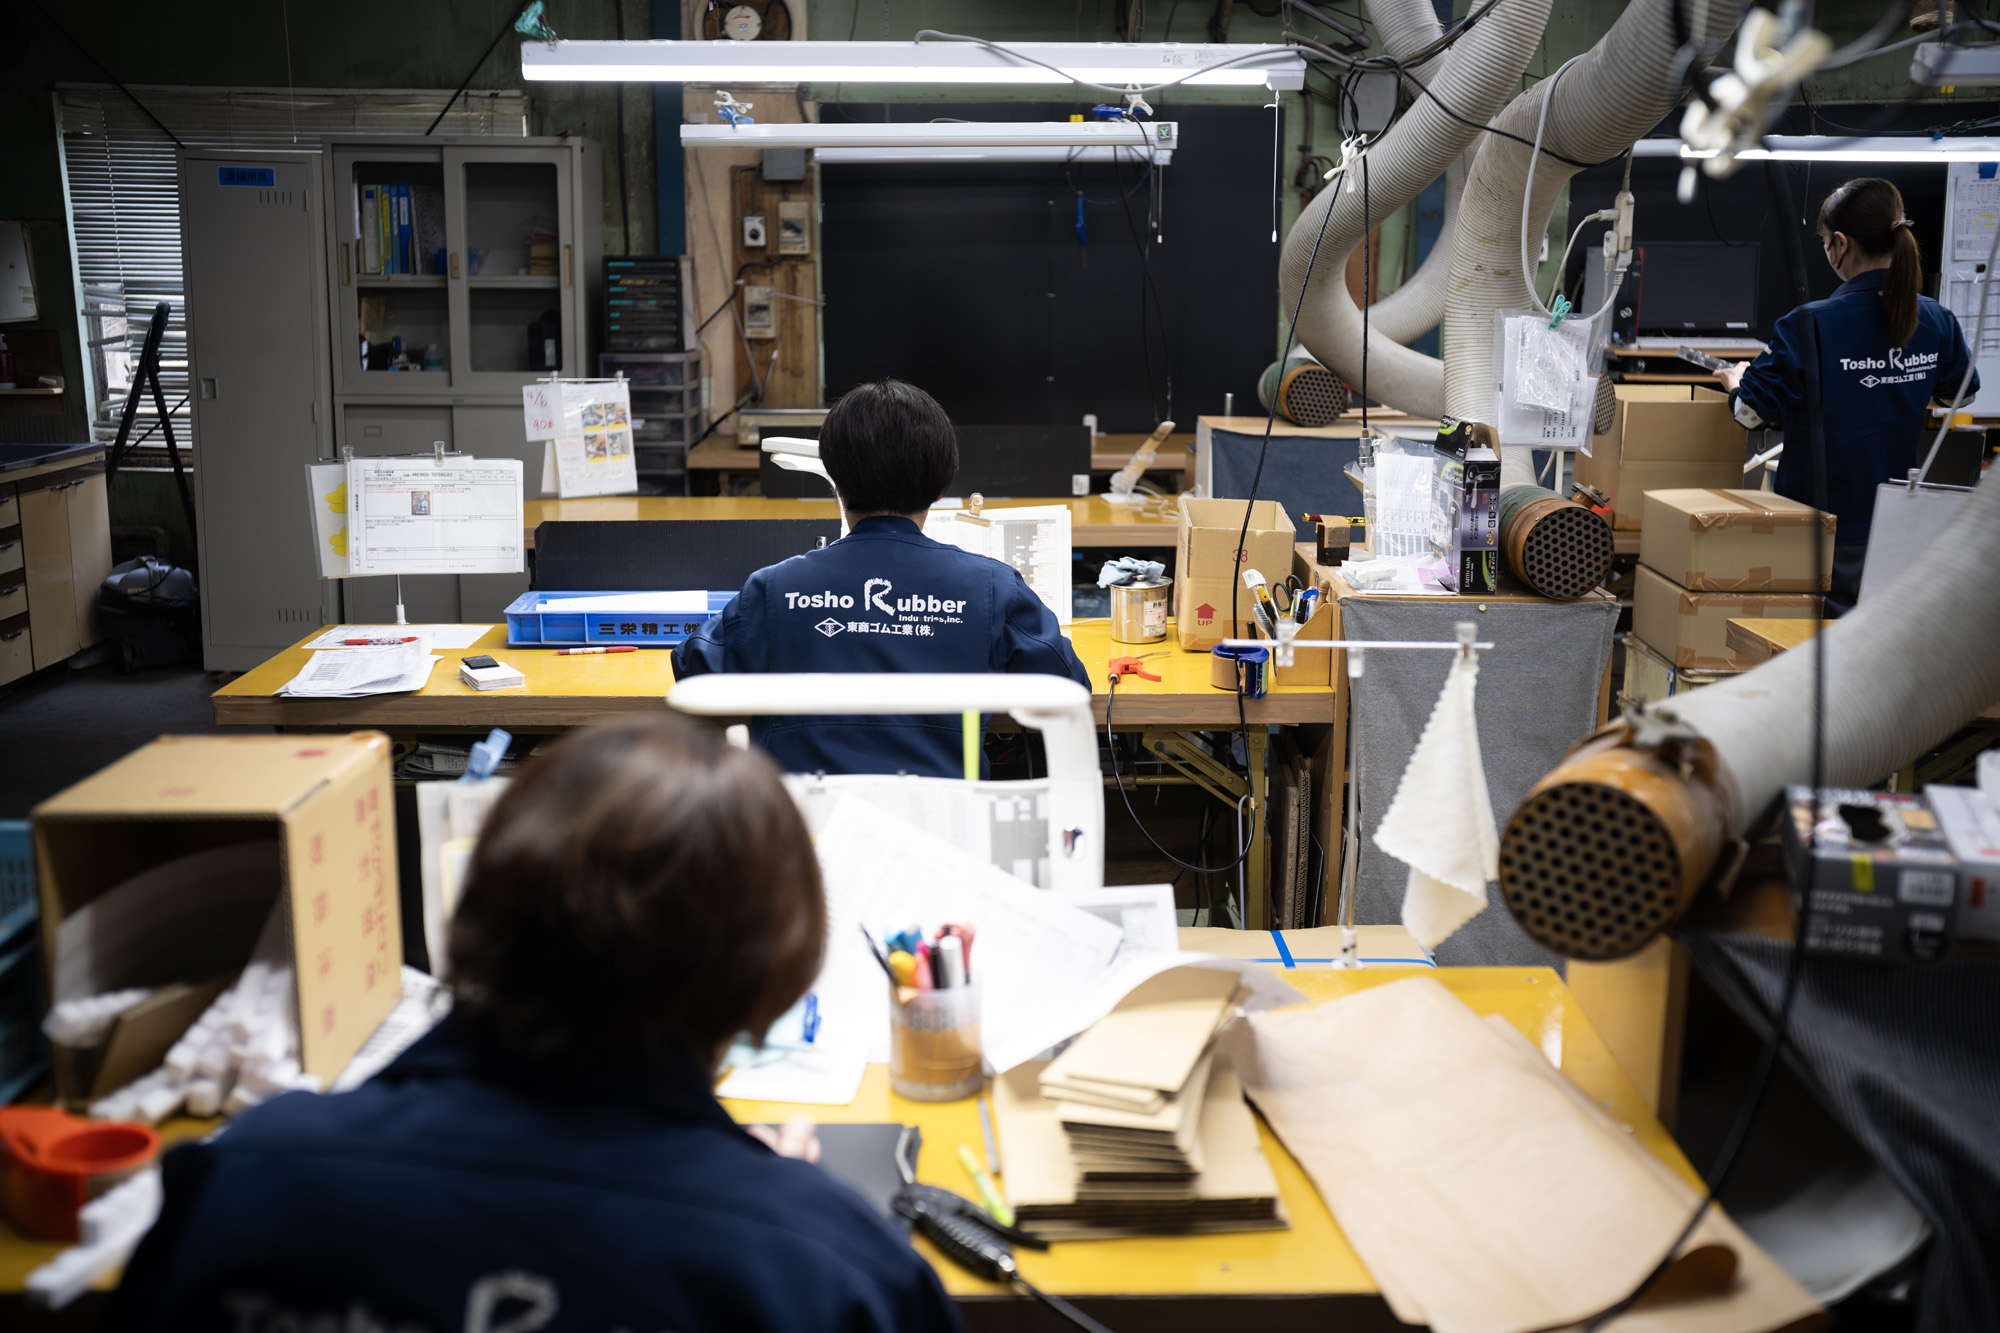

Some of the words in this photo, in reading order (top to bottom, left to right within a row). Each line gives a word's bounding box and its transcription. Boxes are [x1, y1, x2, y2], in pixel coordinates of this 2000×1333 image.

[1839, 357, 1887, 371] Tosho
[1888, 346, 1939, 371] Rubber
[1231, 548, 1249, 563] 38
[784, 590, 855, 610] Tosho
[863, 577, 967, 617] Rubber
[1196, 619, 1214, 627] UP
